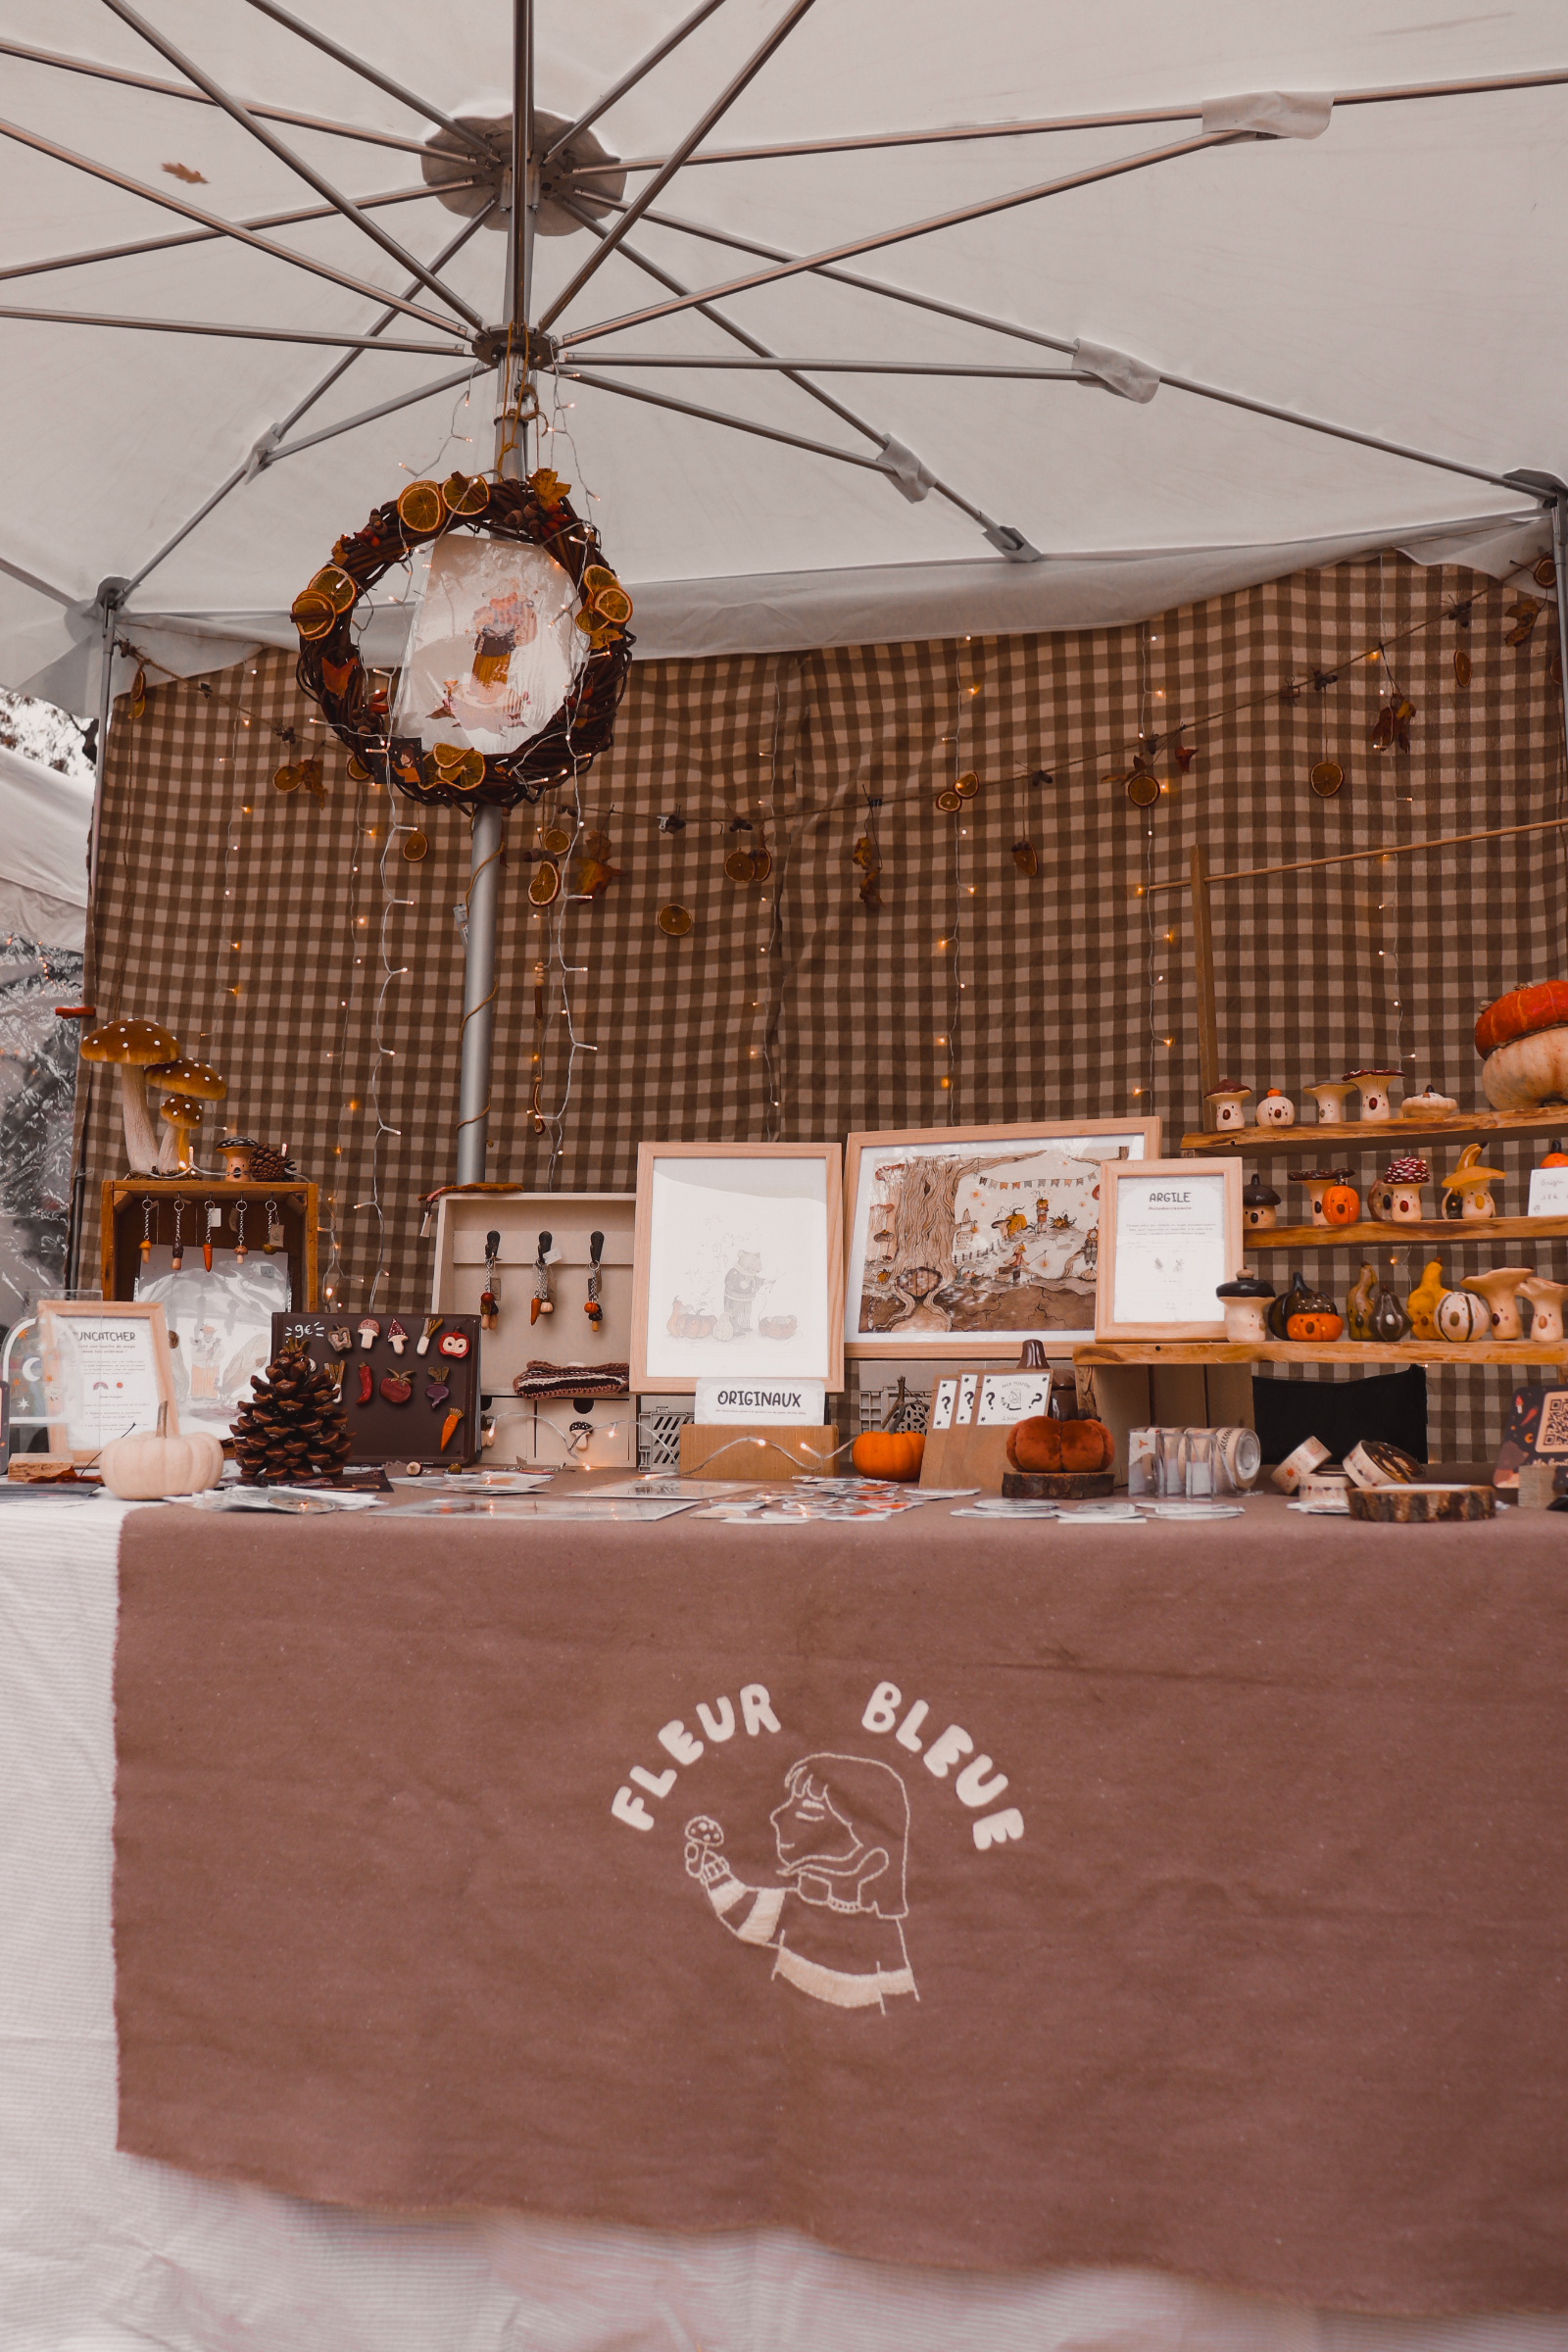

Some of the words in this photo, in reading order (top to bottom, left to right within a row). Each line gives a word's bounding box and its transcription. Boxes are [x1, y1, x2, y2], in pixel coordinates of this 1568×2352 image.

[1149, 1192, 1192, 1203] ARGILE
[73, 1331, 136, 1342] UNCATCHER
[294, 1324, 314, 1339] 9€
[717, 1391, 802, 1408] ORIGINAUX
[612, 1683, 781, 1831] FLEUR
[861, 1682, 1024, 1850] BLEUE
